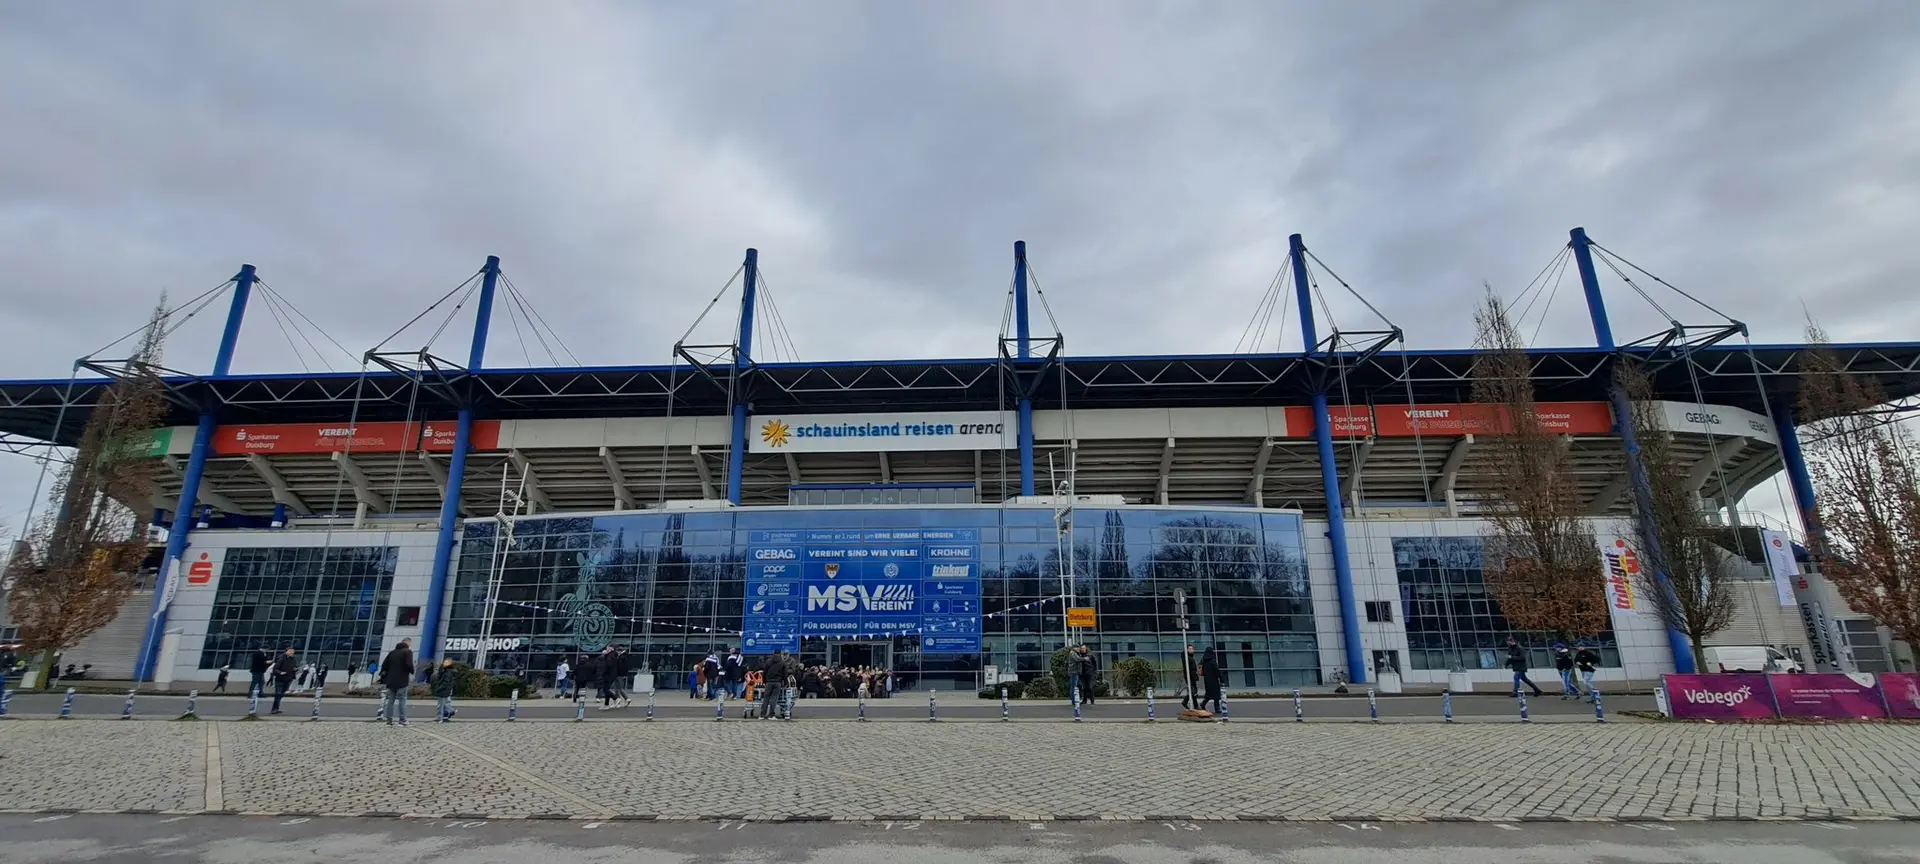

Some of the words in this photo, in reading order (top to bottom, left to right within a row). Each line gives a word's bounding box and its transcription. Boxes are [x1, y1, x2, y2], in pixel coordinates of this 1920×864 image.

[1404, 410, 1449, 418] VEREINT
[1686, 412, 1720, 424] GEBAG
[318, 428, 358, 436] VEREINT
[435, 430, 456, 438] Sparka
[797, 421, 900, 439] schauinsland
[905, 420, 954, 437] reisen
[960, 422, 1005, 436] arena
[247, 433, 280, 442] Sparkasse
[433, 437, 456, 446] Duisbu
[245, 441, 275, 450] Duisburg
[809, 550, 845, 558] VEREINT
[847, 549, 868, 558] SIND
[871, 549, 888, 558] WIR
[889, 549, 918, 558] VIELE!
[803, 621, 818, 630] FÜR
[820, 622, 858, 630] DUISBURG
[864, 620, 880, 630] FÜR
[881, 622, 897, 630] DEN
[899, 621, 917, 630] MSV
[1800, 602, 1827, 665] Sparkassen
[1684, 688, 1743, 706] Vebego
